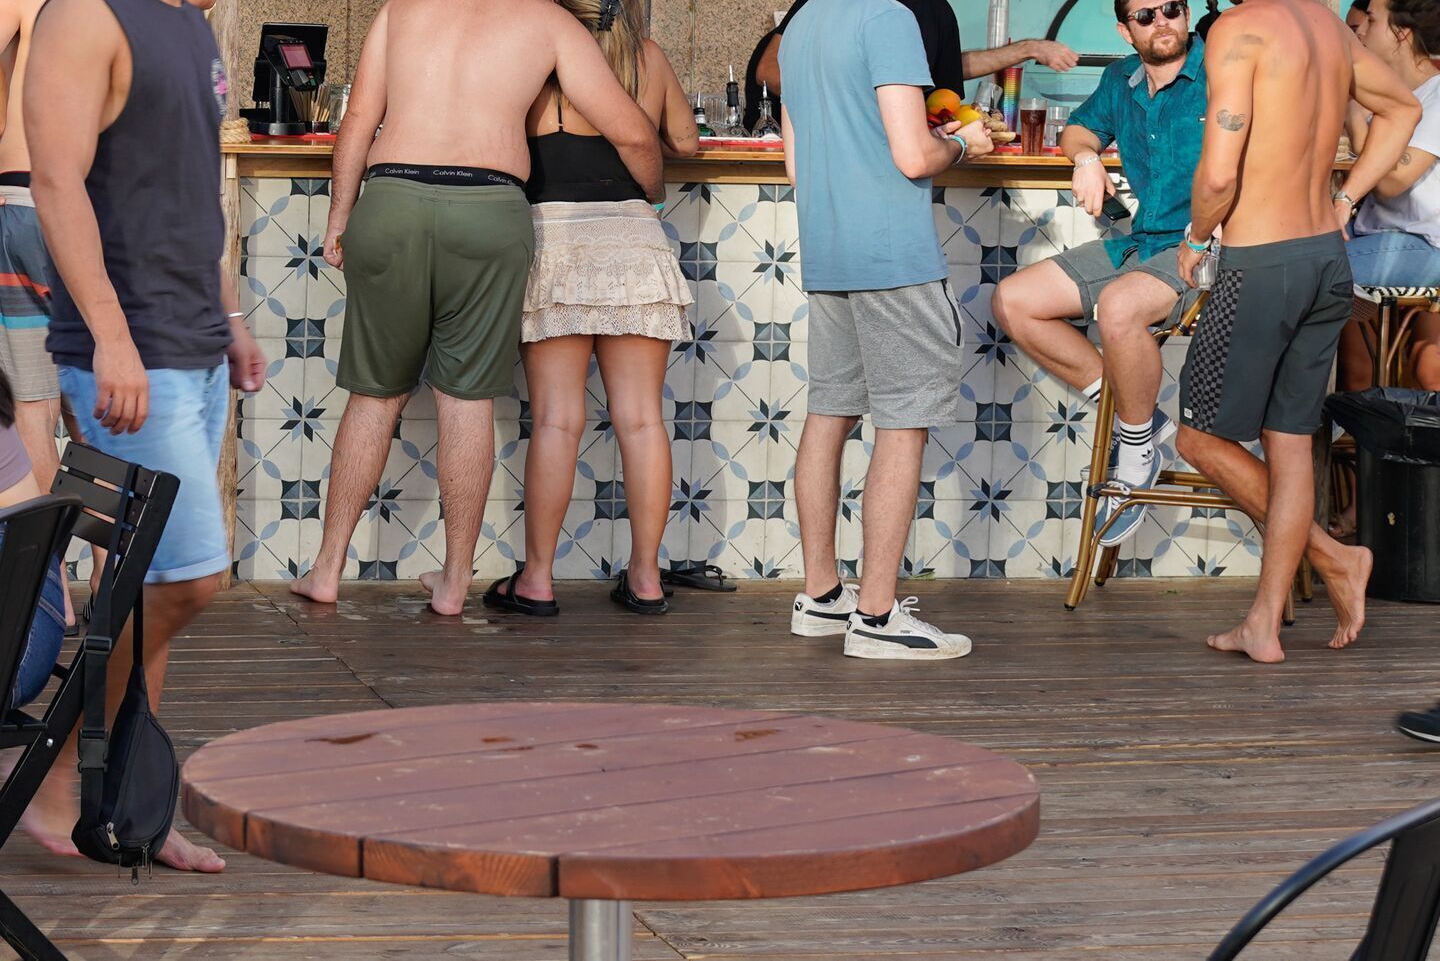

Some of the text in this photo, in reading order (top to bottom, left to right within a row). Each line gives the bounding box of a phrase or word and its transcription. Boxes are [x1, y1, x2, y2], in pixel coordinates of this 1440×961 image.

[384, 167, 403, 175] Calvin
[432, 168, 456, 176] Calvin
[456, 170, 474, 178] Klein
[487, 174, 507, 184] Calvin
